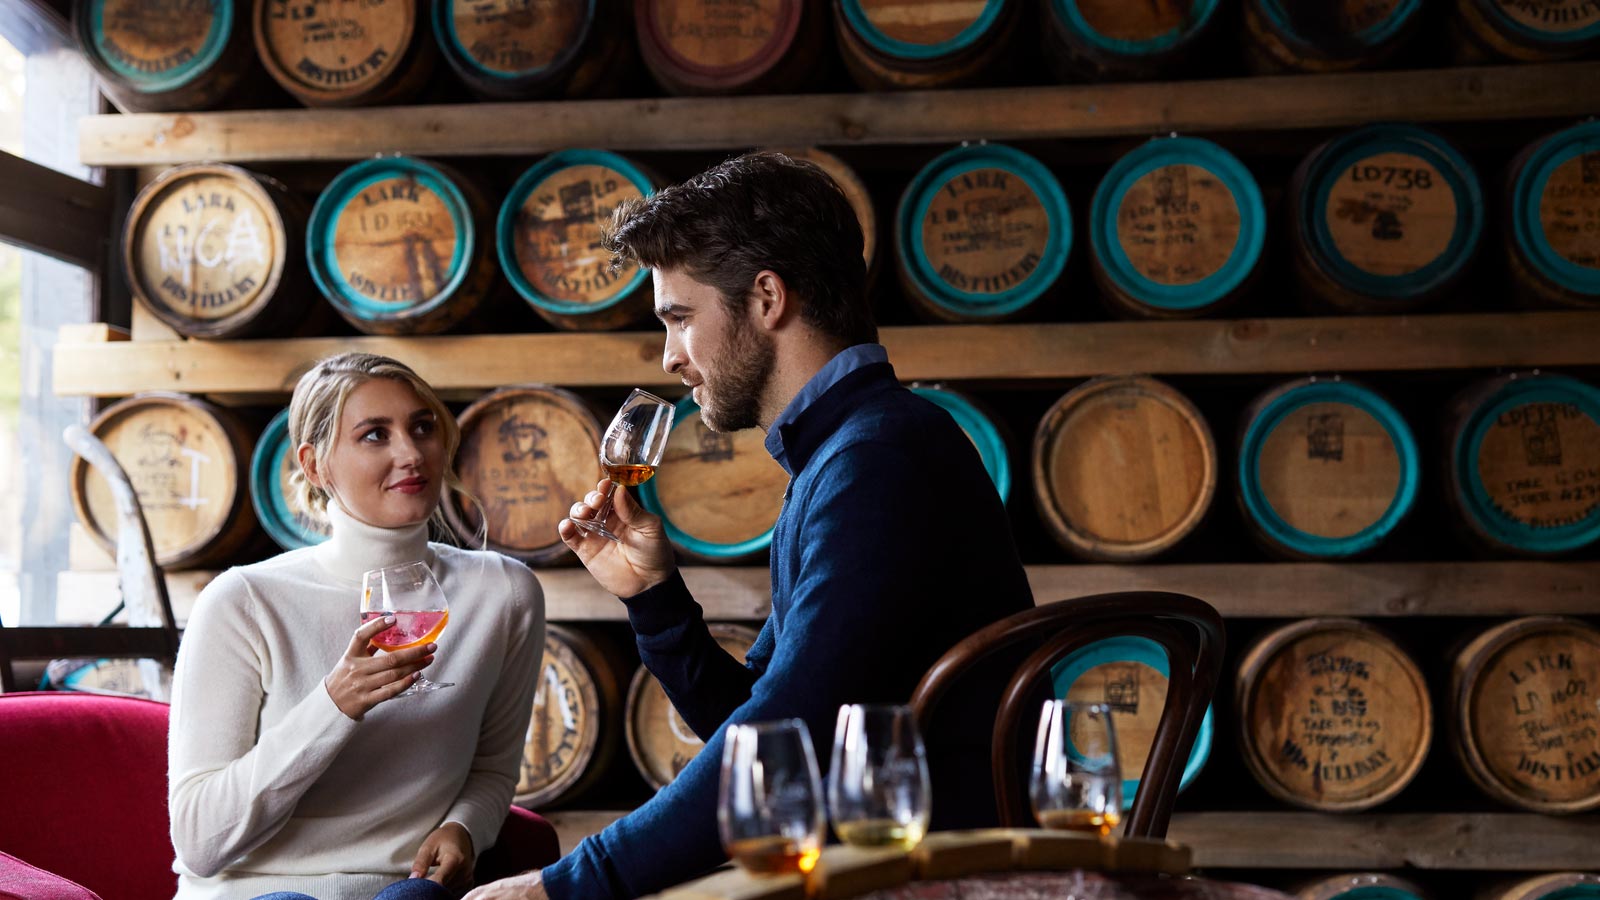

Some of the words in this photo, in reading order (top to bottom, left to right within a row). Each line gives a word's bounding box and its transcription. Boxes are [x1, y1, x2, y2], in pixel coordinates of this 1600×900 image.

[297, 48, 387, 84] DISTILLERY
[946, 172, 1004, 198] LARK
[1352, 165, 1432, 191] LD738
[182, 193, 236, 213] LARK
[362, 184, 419, 206] LARK
[940, 252, 1040, 291] DISTILLERY
[162, 276, 255, 308] DISTILLERY
[1509, 653, 1573, 685] LARK
